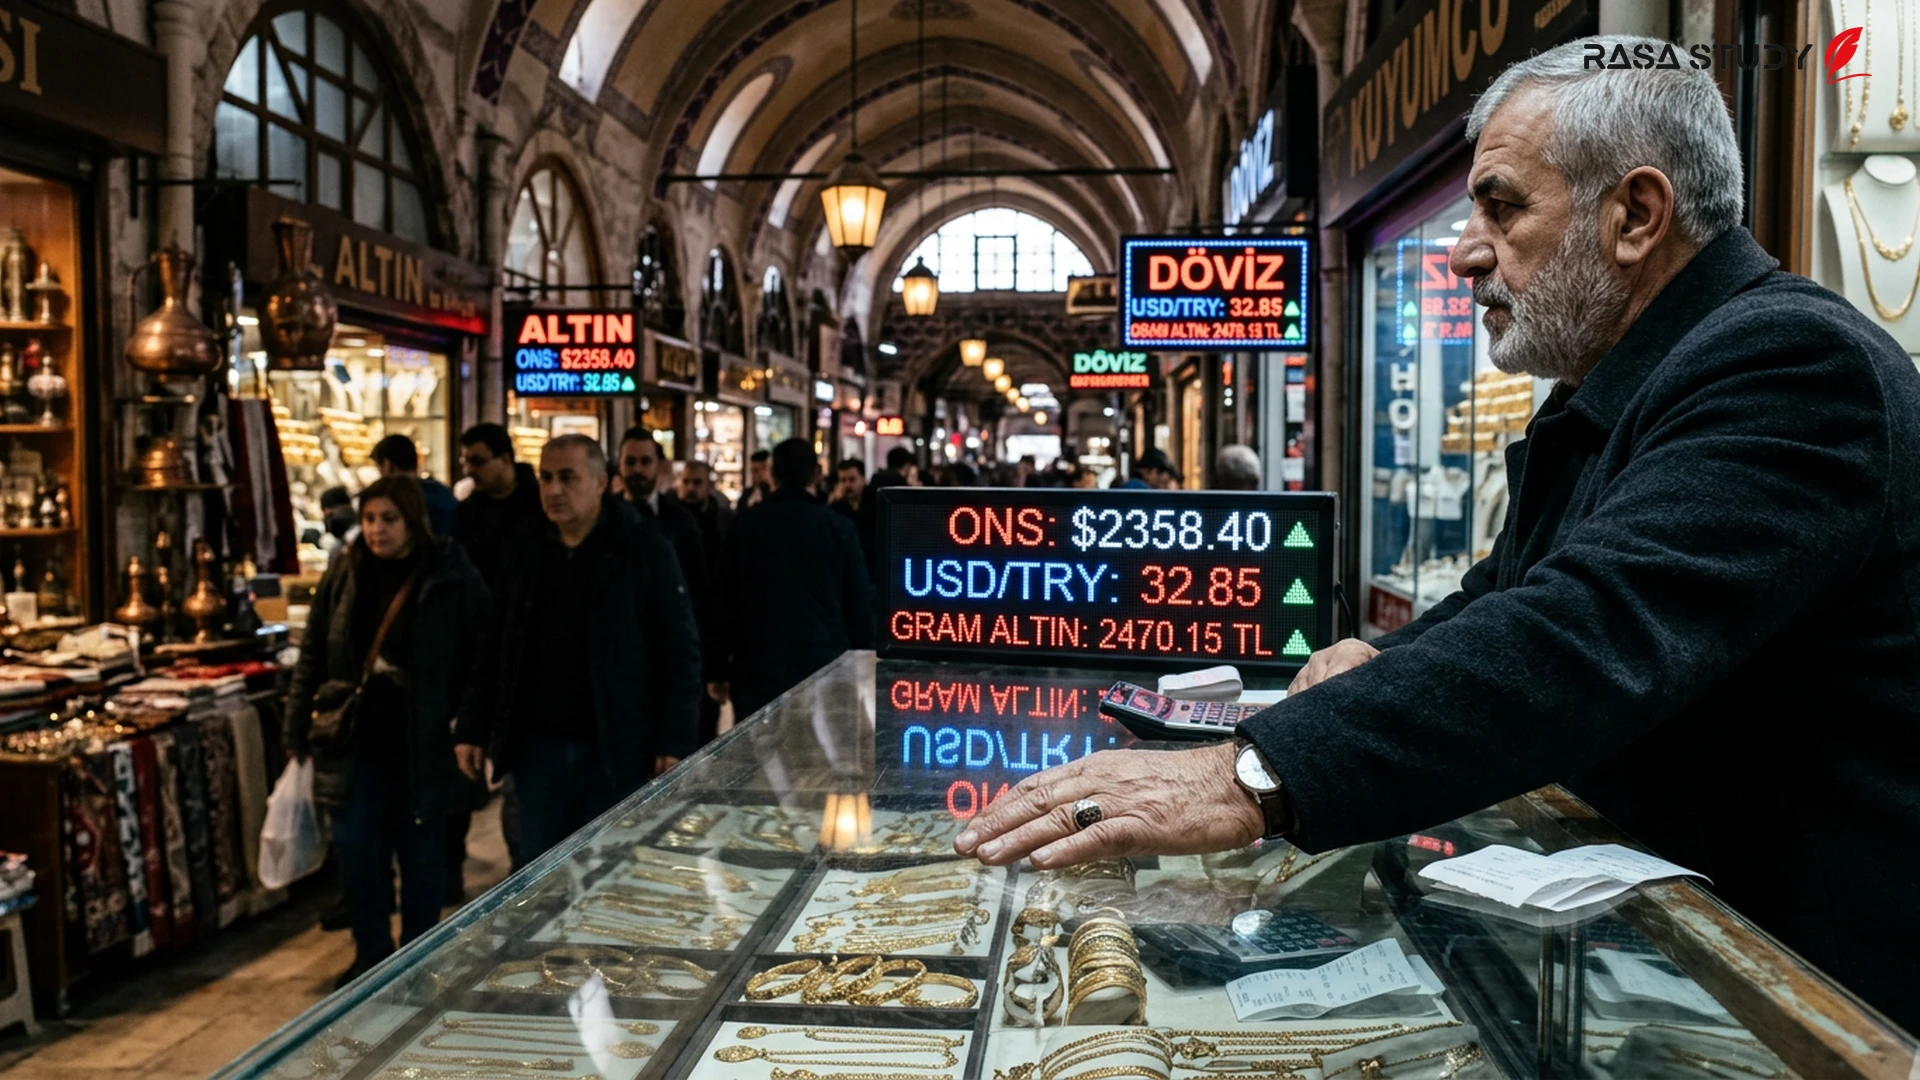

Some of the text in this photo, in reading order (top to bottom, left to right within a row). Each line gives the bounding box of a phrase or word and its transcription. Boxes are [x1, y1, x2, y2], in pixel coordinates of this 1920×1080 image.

[334, 234, 424, 306] ALTIN
[1149, 247, 1285, 290] DÖVİZ
[518, 314, 634, 344] ALTIN
[1131, 298, 1283, 317] USD/TRY: 32.85
[515, 348, 559, 369] ONS:
[948, 506, 1272, 551] ONS: $2358.40
[904, 558, 1262, 607] USD/TRY: 32.85
[891, 610, 1272, 656] GRAM ALTIN: 2470.15 TL
